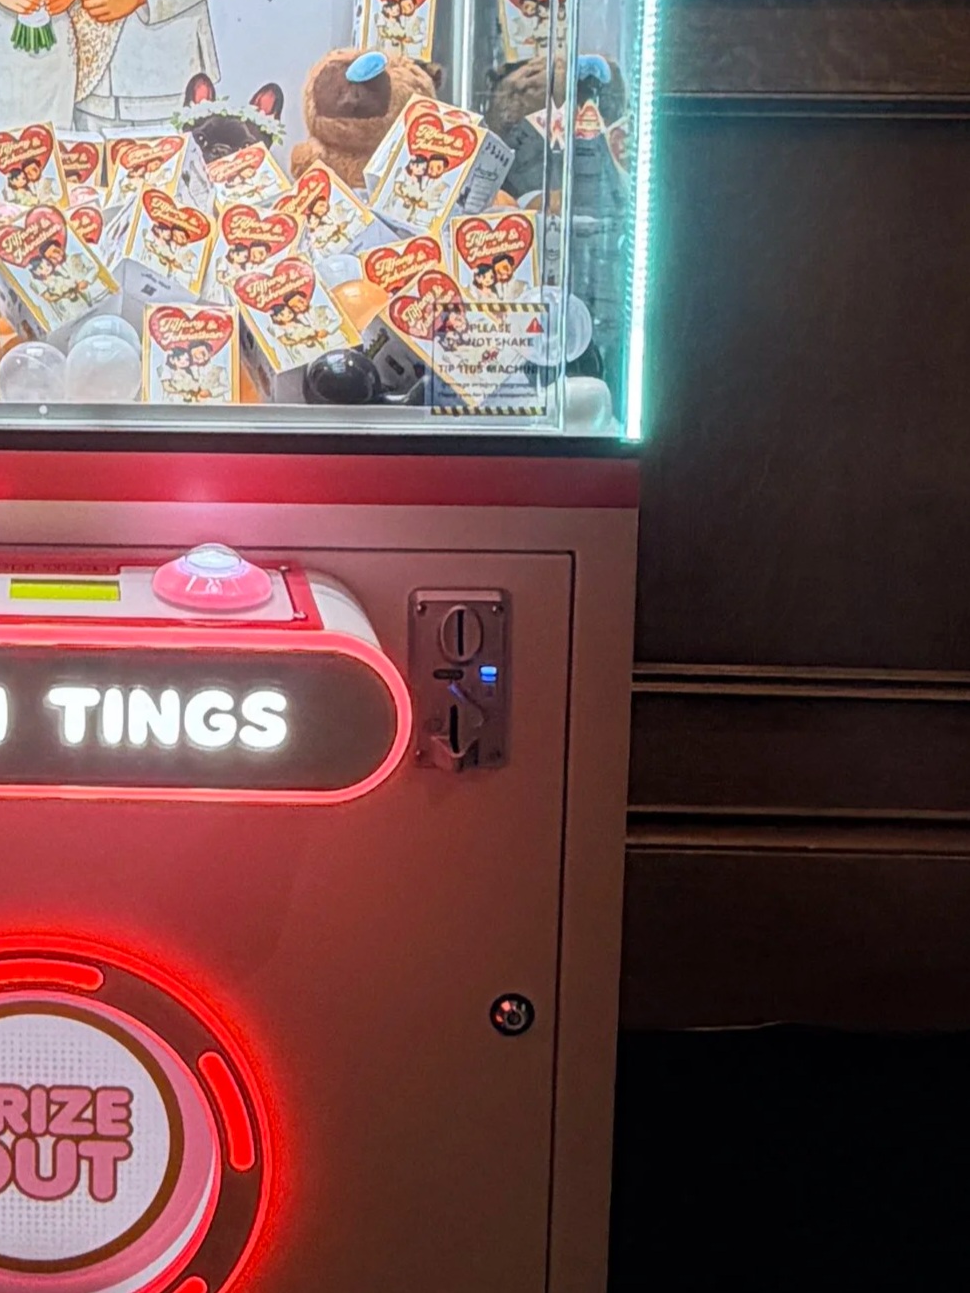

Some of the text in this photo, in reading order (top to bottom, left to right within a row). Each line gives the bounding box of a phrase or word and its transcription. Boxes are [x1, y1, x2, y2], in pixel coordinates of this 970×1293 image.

[469, 324, 512, 333] PLEASE
[494, 338, 535, 347] SHAKE
[486, 365, 541, 374] MACHIN
[46, 685, 289, 749] TINGS
